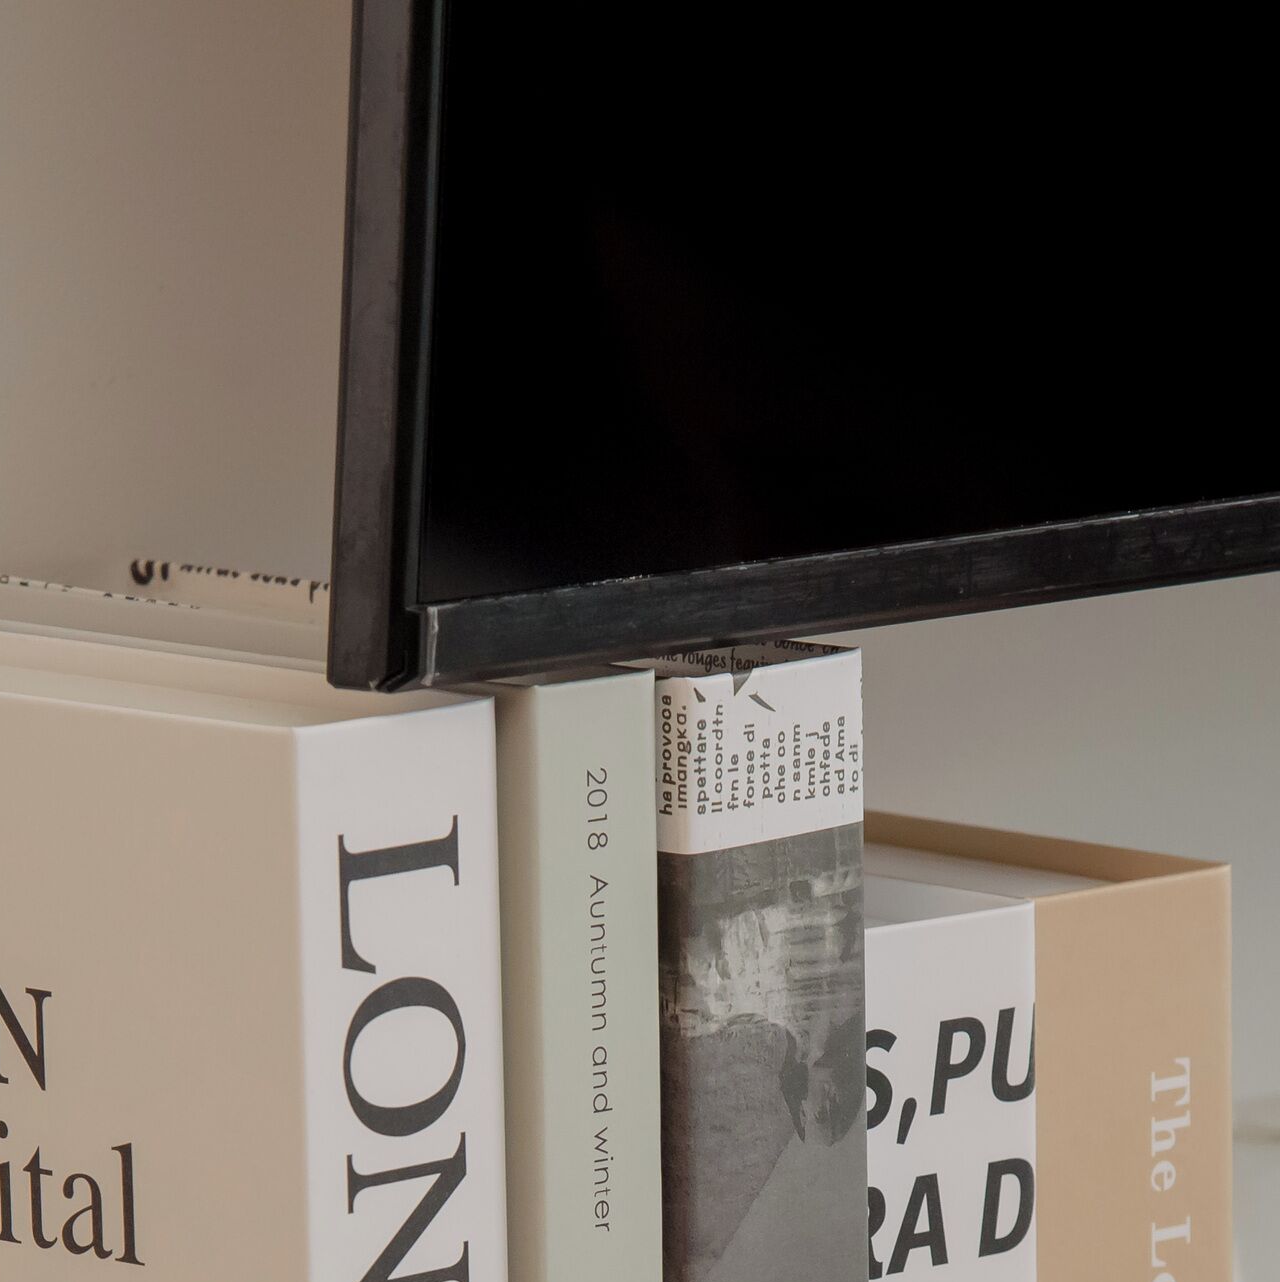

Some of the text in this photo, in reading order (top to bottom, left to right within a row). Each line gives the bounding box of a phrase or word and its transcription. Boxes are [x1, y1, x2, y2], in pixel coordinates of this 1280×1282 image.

[693, 718, 710, 816] spettare
[742, 722, 755, 809] forse di
[759, 737, 774, 800] potta
[792, 788, 801, 802] n
[834, 715, 846, 795] ad Ama
[848, 743, 859, 794] to di
[586, 766, 614, 1233] 2018 Auntumn and winter
[1150, 1056, 1192, 1194] The
